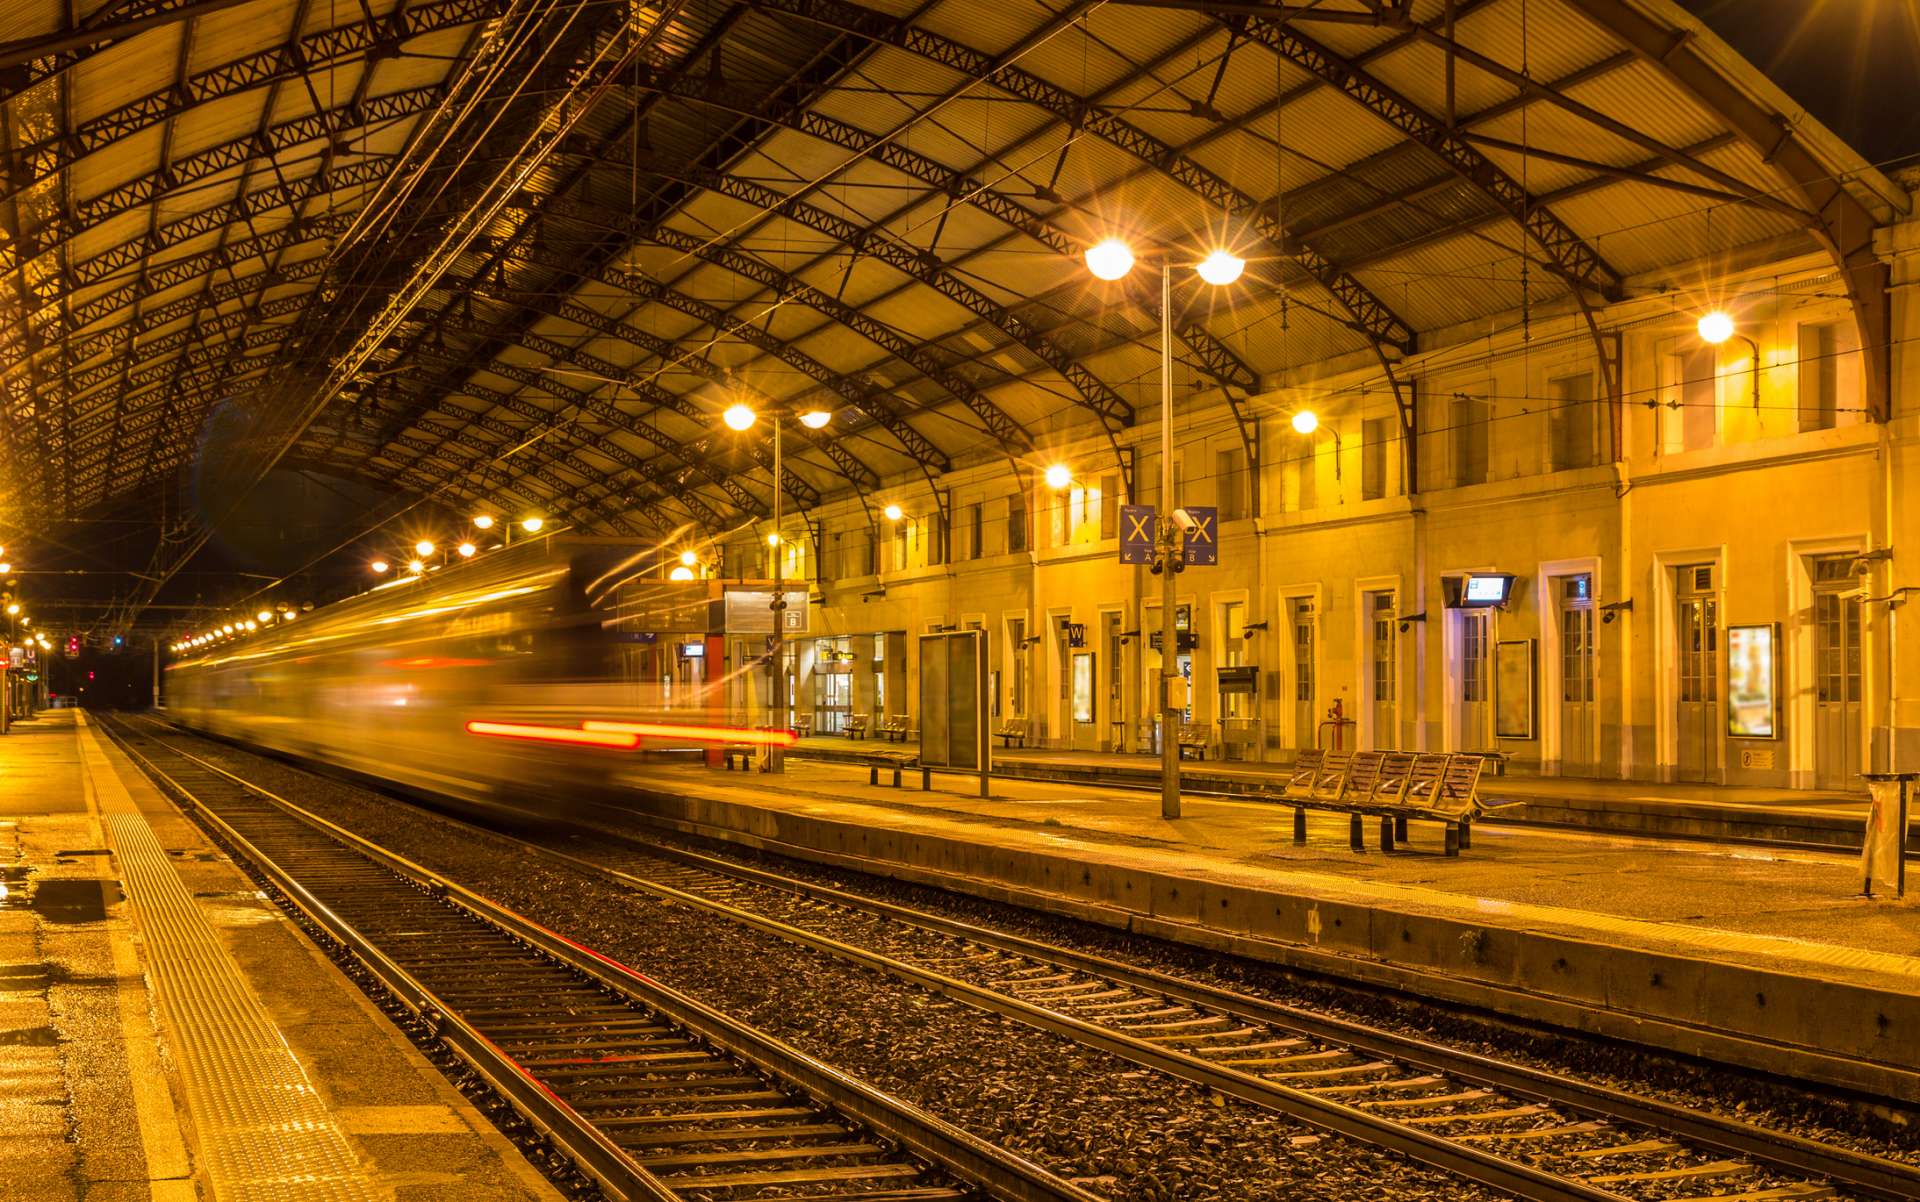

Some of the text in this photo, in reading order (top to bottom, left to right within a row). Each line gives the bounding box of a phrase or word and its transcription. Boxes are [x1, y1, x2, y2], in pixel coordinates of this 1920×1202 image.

[1127, 514, 1149, 542] X
[1190, 516, 1212, 543] X
[1144, 553, 1151, 561] A
[1070, 626, 1082, 639] W
